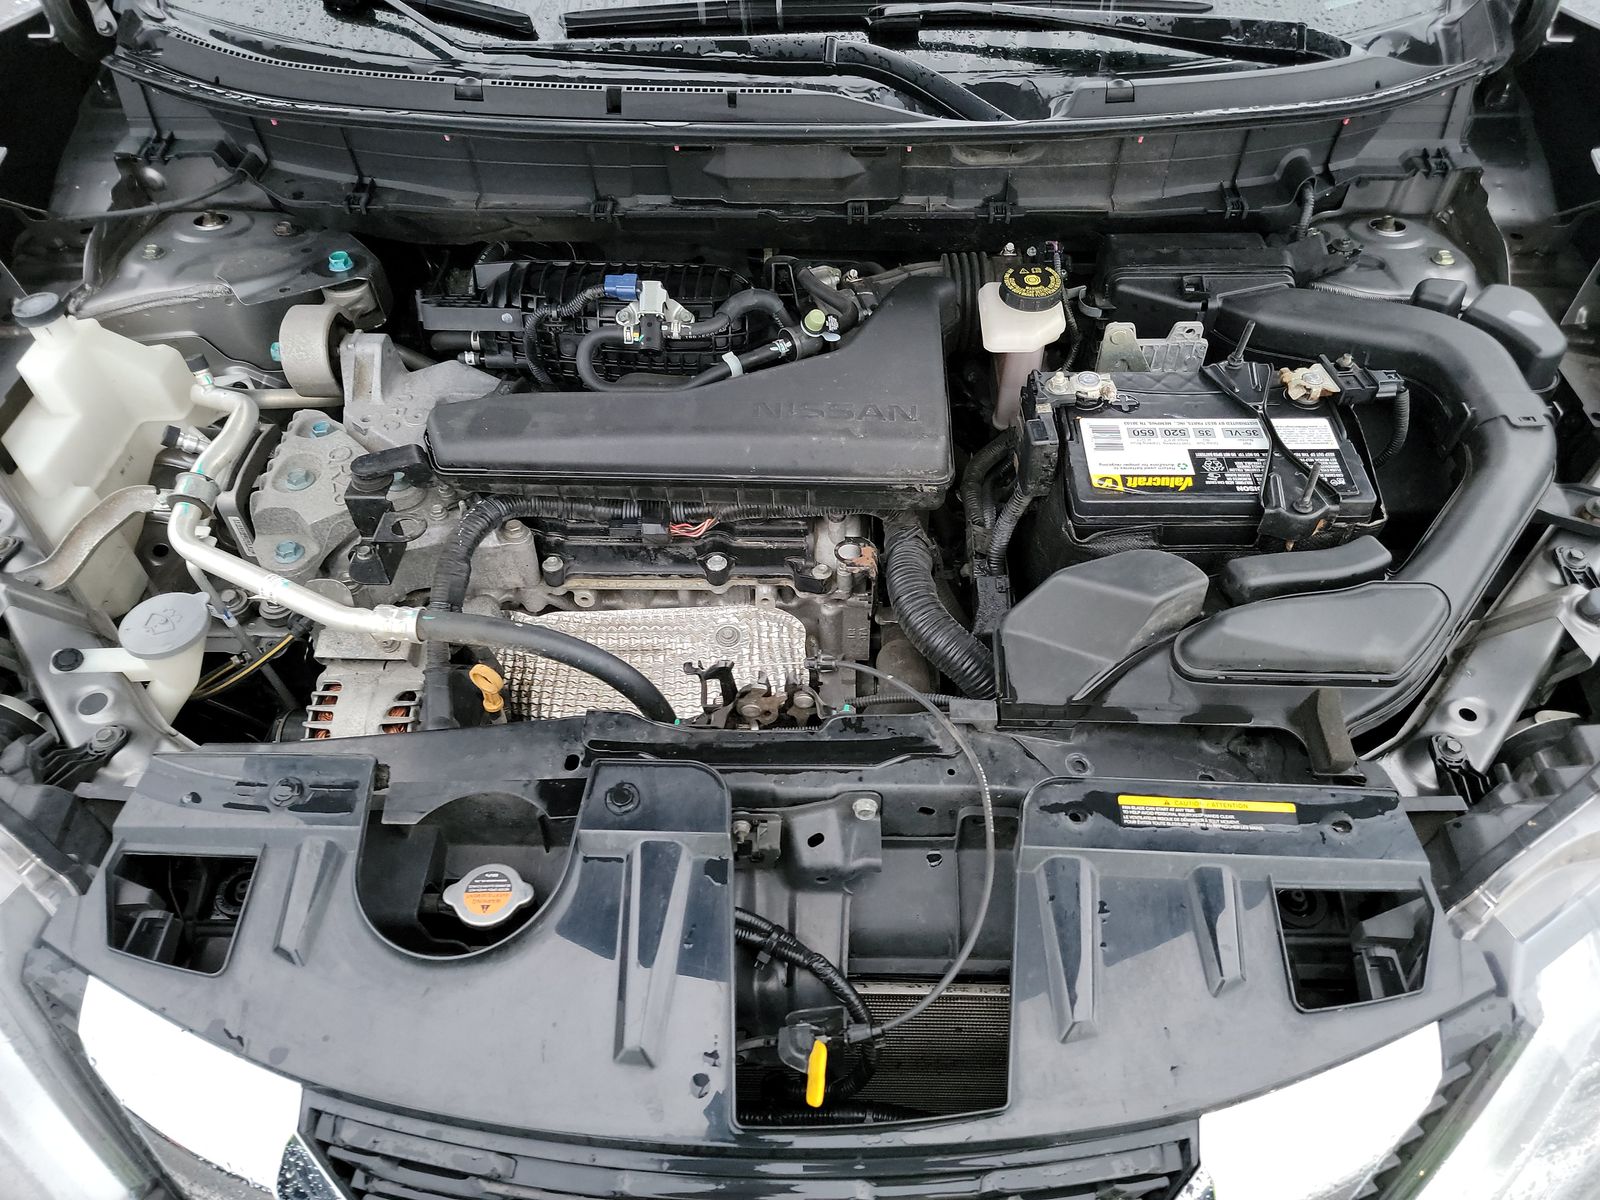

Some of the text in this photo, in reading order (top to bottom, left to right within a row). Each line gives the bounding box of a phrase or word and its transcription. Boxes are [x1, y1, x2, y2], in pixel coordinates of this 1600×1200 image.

[751, 400, 919, 422] NISSAN
[1132, 429, 1155, 437] 650
[1164, 429, 1186, 437] 520
[1198, 429, 1212, 437] 35
[1225, 429, 1259, 437] 35-VL
[1126, 476, 1194, 491] Valucraft
[1211, 801, 1248, 809] ATTENTION
